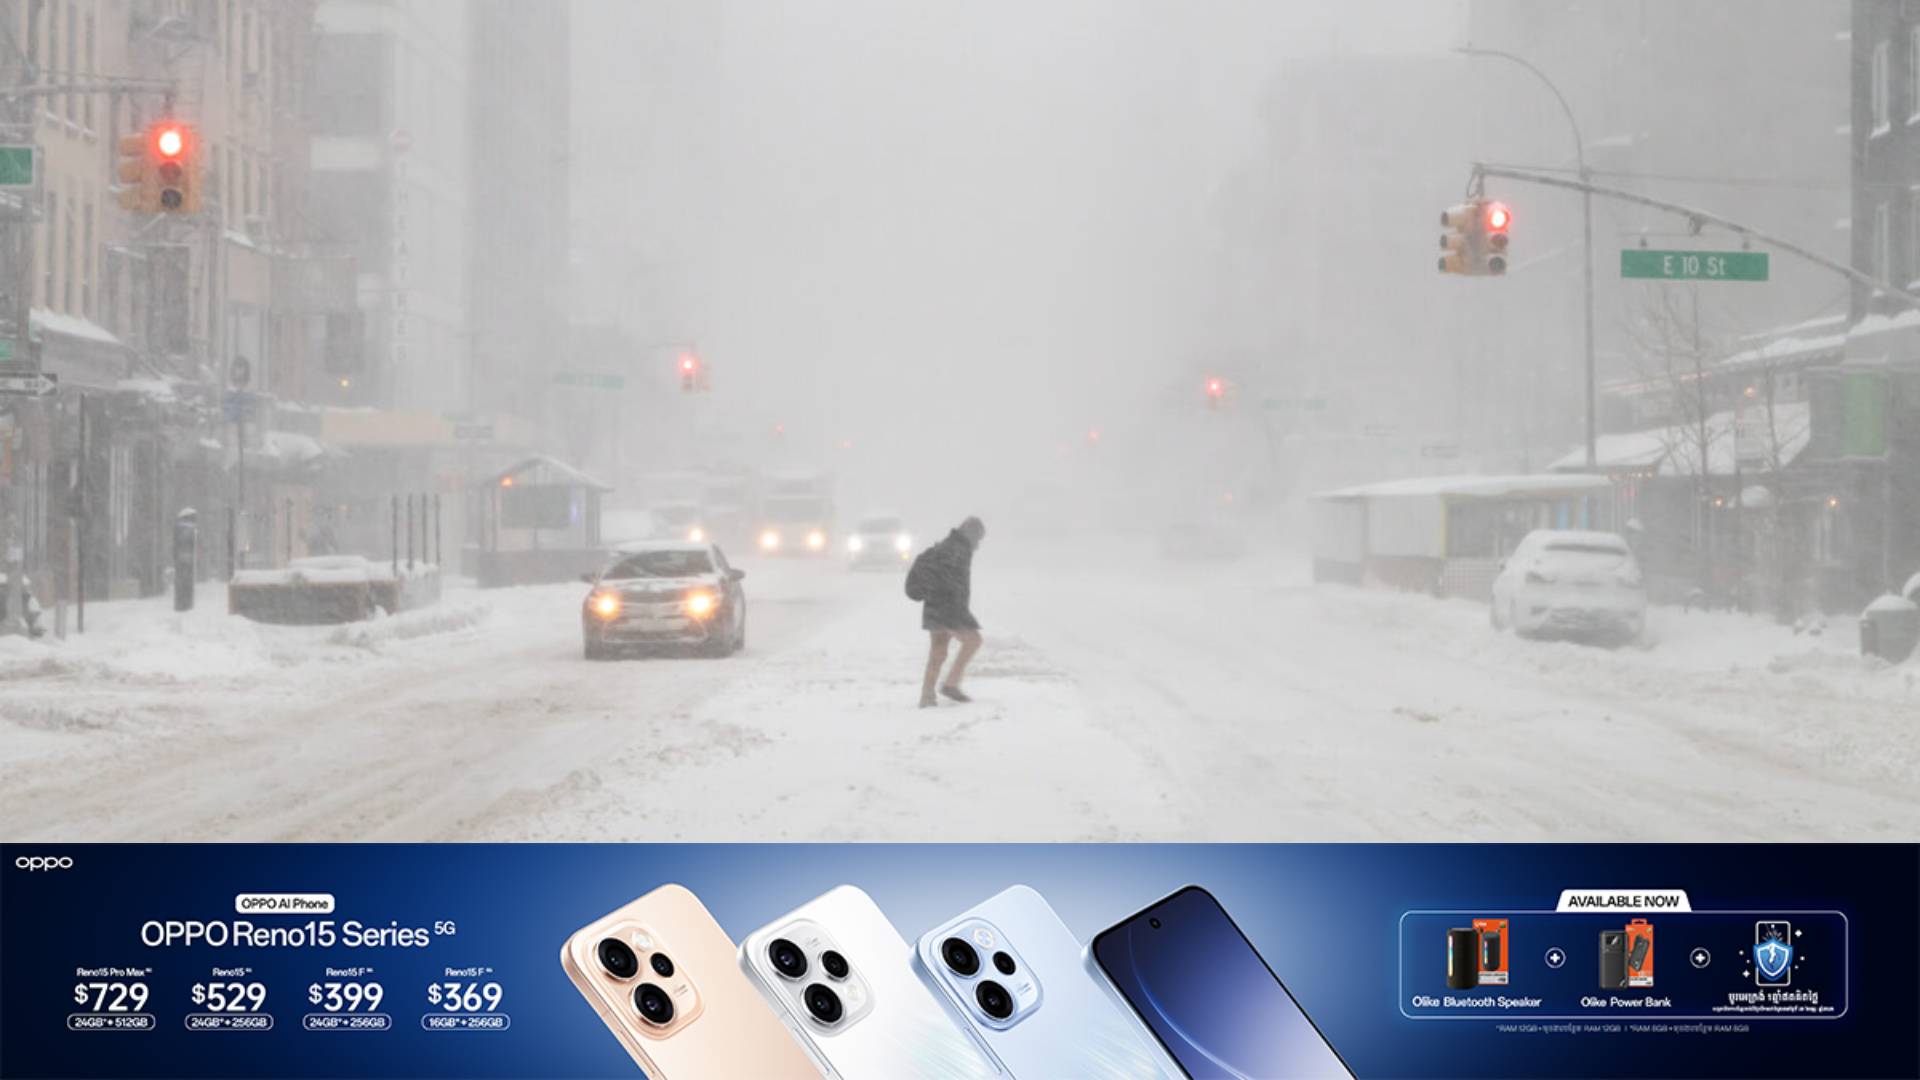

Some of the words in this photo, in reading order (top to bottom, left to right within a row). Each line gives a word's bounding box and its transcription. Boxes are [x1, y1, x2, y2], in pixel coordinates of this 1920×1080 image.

[1663, 254, 1674, 275] E
[1681, 255, 1700, 276] 10
[1706, 255, 1726, 277] St
